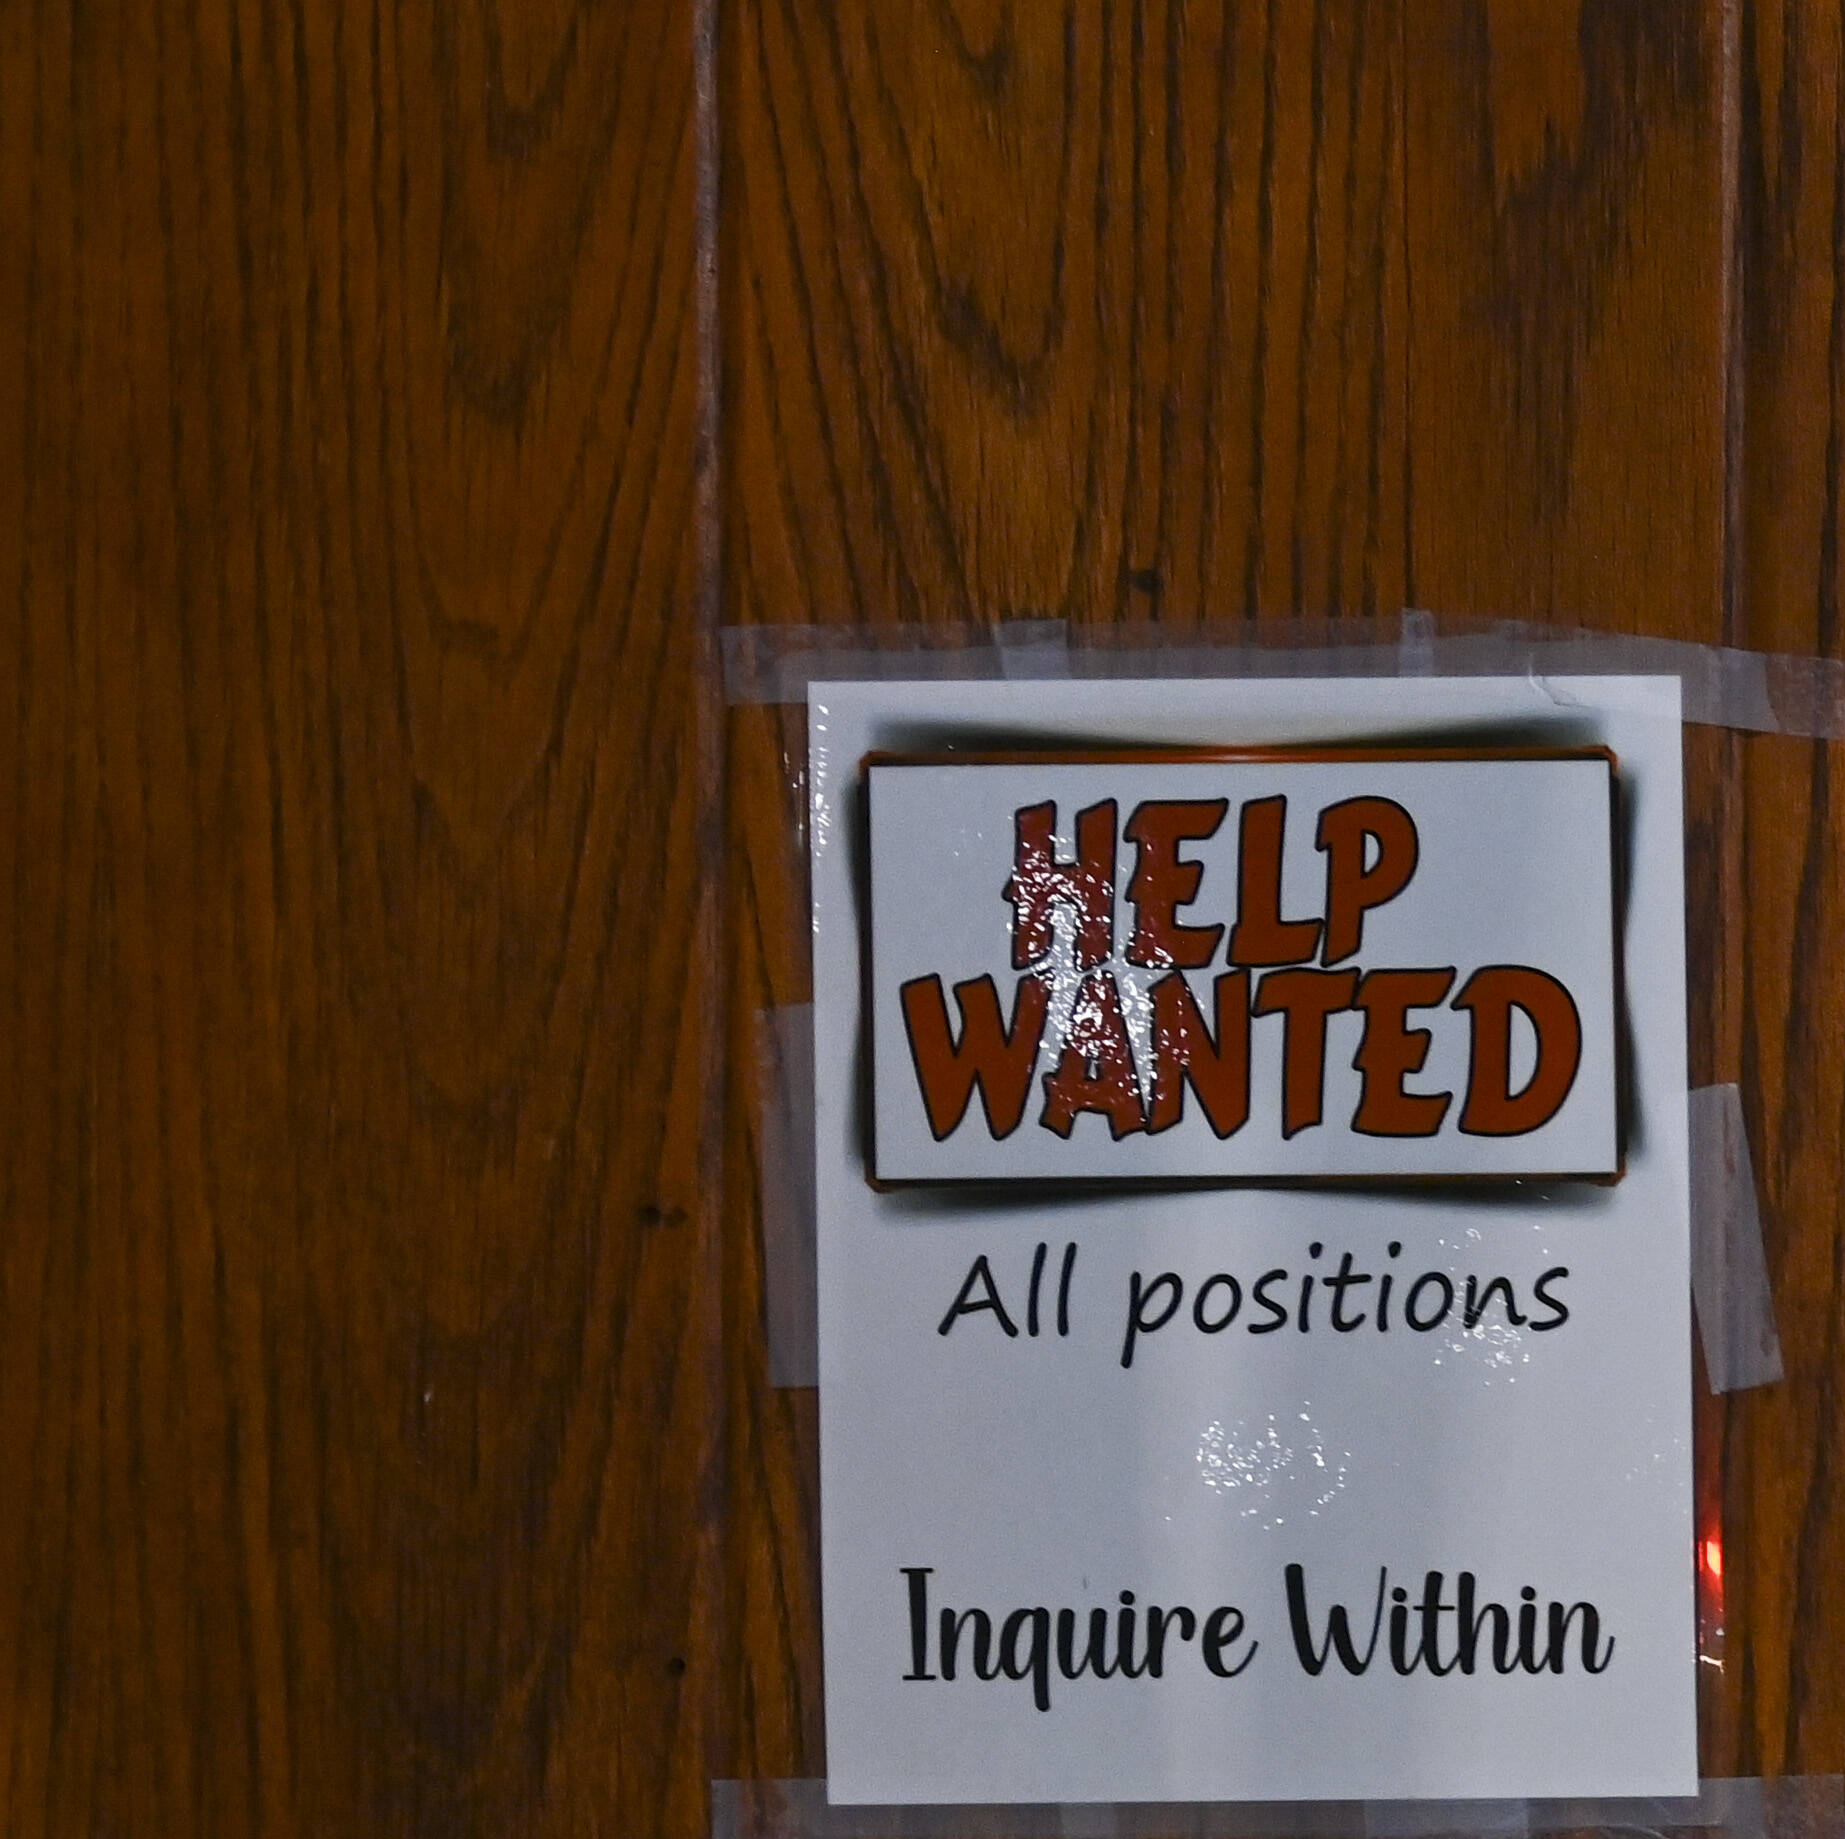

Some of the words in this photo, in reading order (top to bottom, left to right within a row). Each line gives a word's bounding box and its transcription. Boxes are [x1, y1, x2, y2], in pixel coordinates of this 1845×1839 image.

[1002, 793, 1421, 970] HELP
[898, 962, 1584, 1142] WANTED
[937, 1241, 1078, 1339] All
[1119, 1240, 1570, 1370] positions
[899, 1567, 1259, 1713] Inquire
[1284, 1562, 1616, 1678] Within
